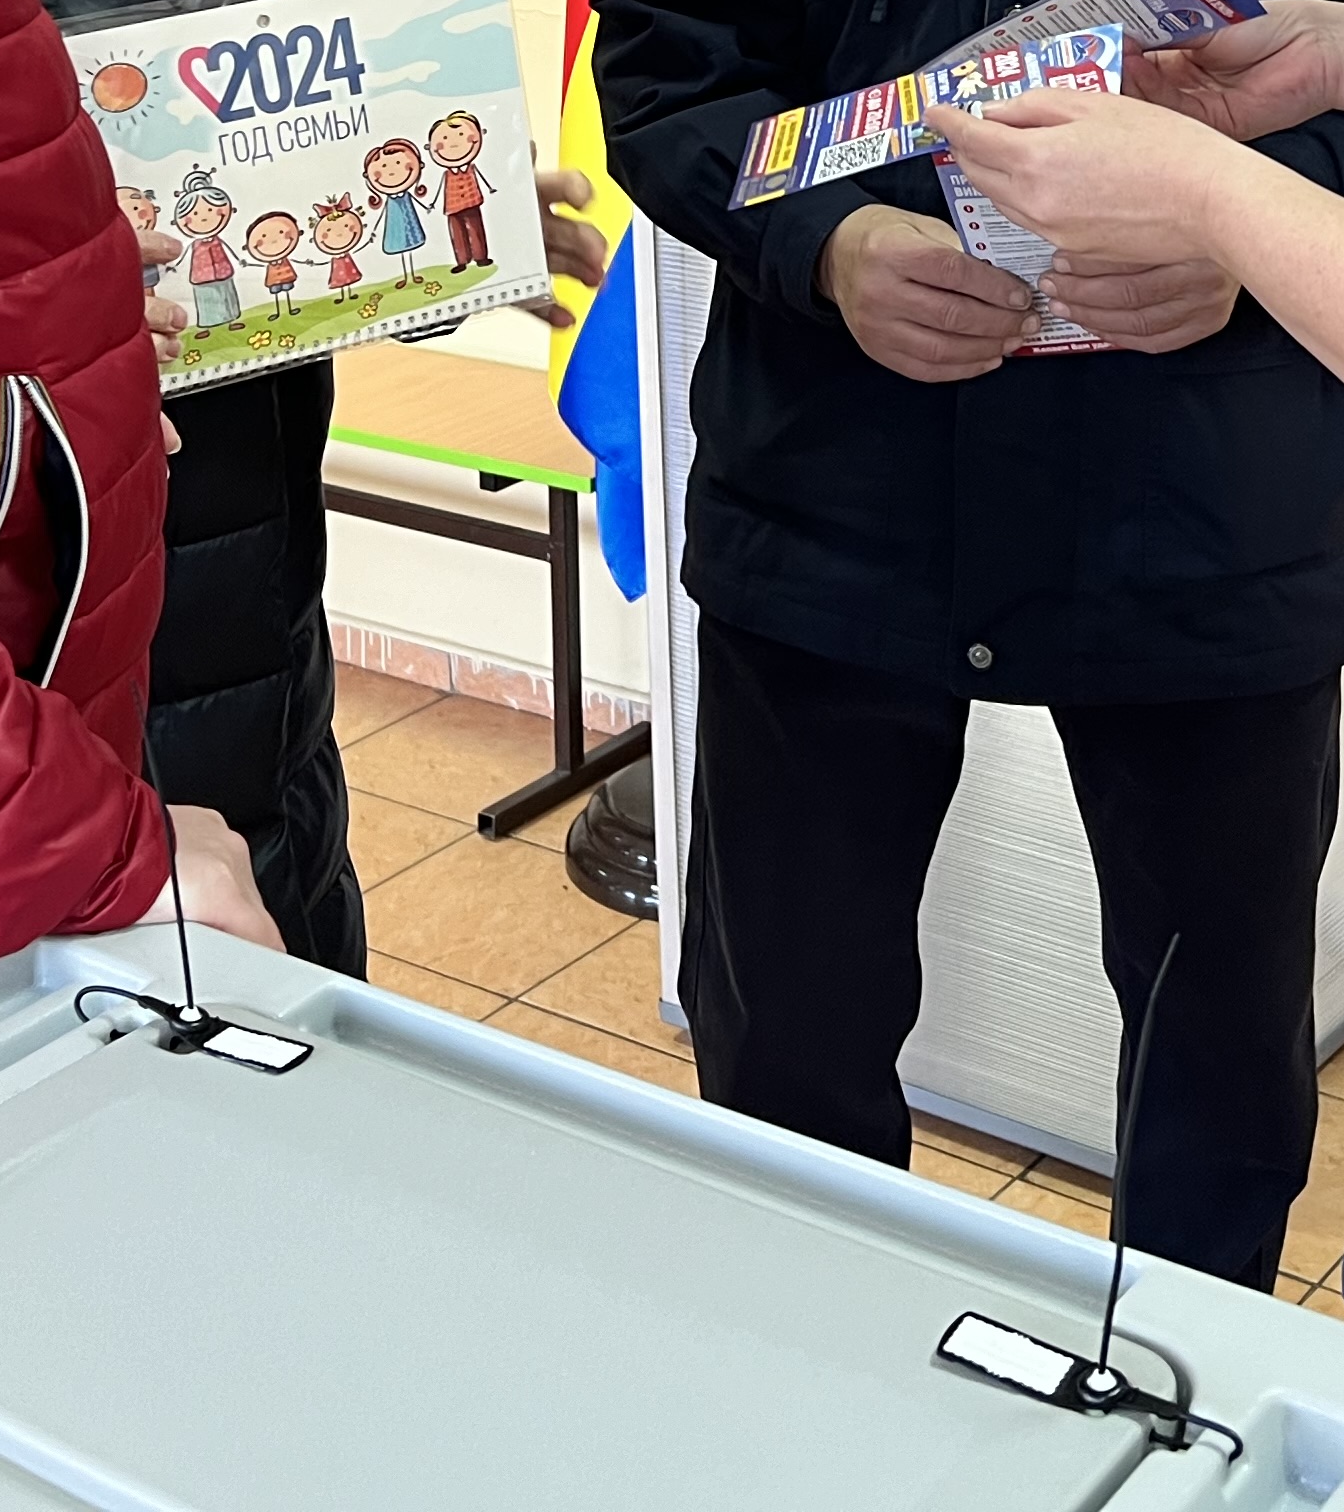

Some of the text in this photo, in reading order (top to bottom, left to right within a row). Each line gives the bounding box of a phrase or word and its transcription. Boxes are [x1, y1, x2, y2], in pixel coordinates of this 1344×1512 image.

[207, 17, 365, 123] 2024
[995, 50, 1022, 78] 2024
[218, 125, 274, 167] ГОД
